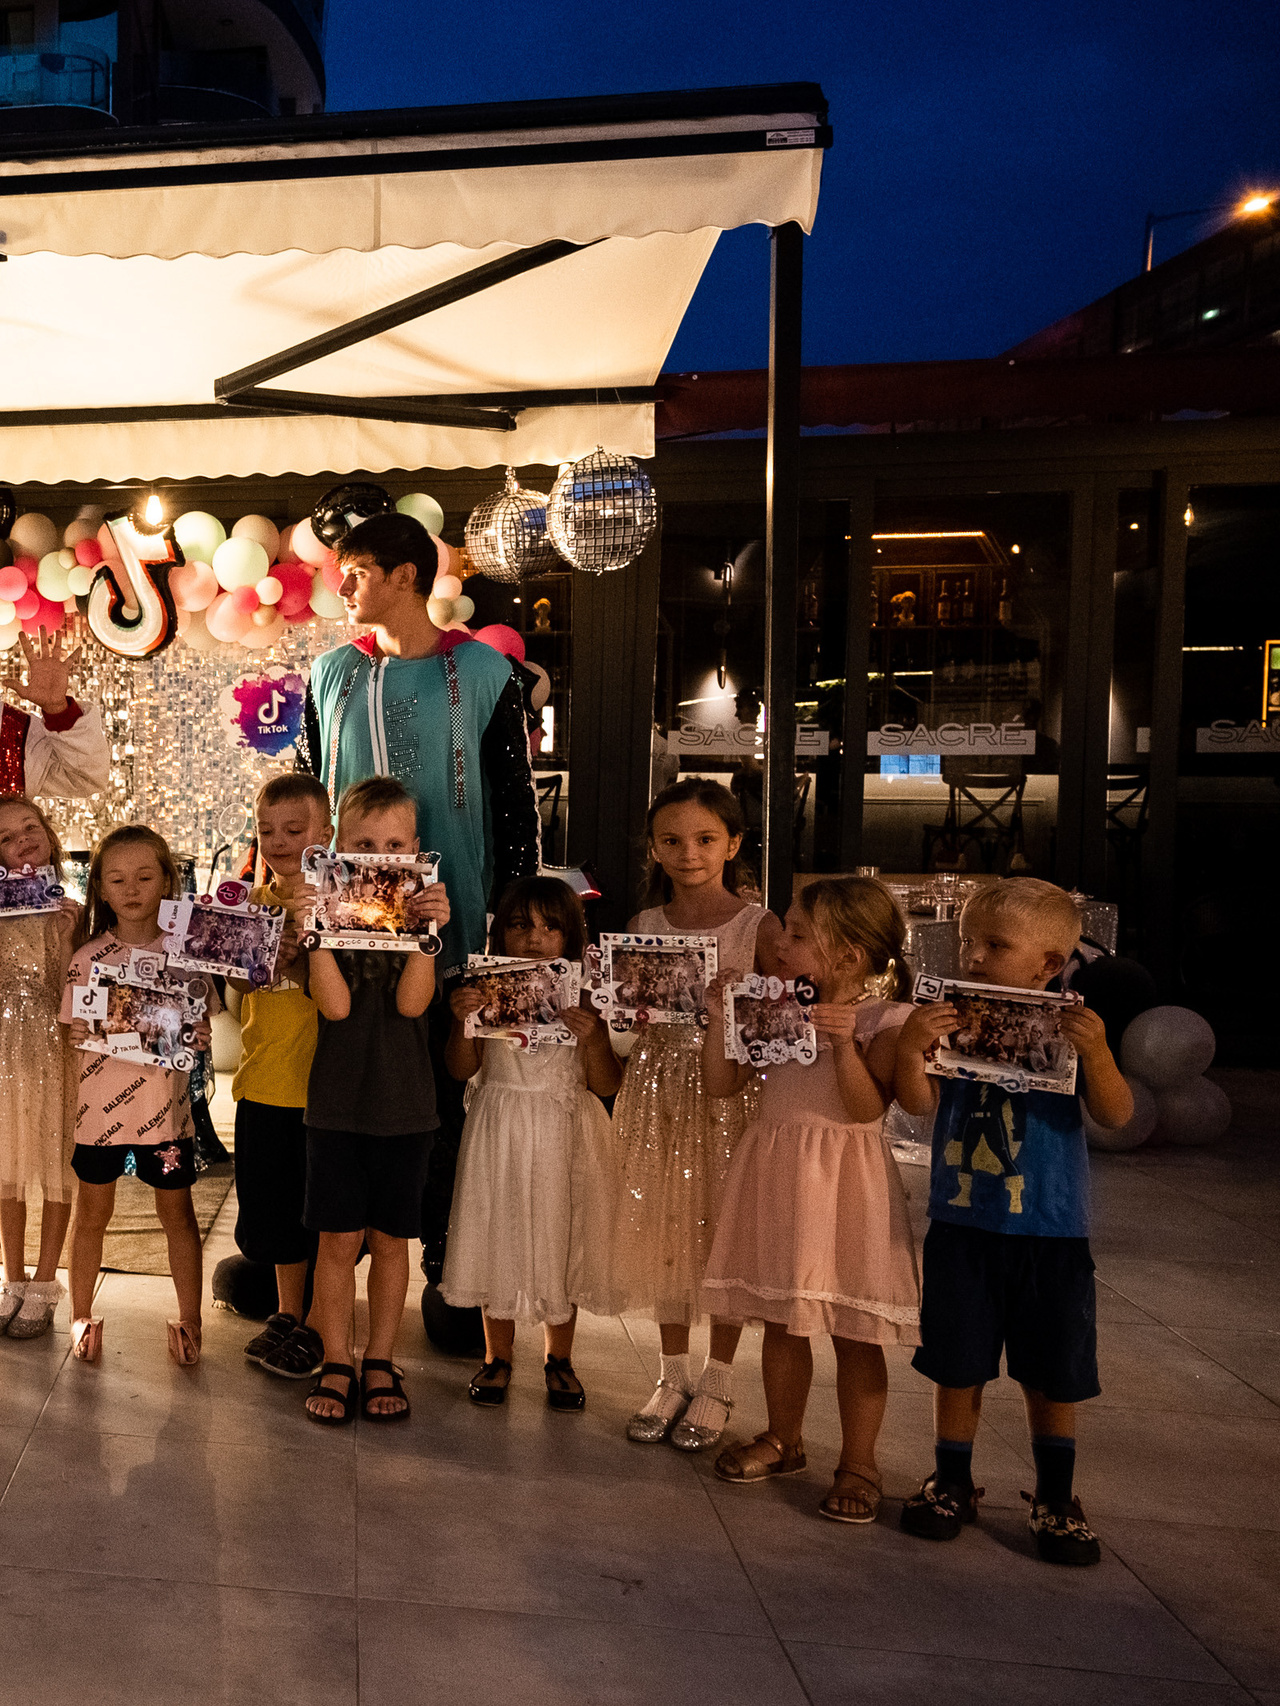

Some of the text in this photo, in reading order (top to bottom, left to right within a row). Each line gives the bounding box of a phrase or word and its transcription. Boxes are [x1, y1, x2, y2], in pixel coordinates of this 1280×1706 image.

[257, 725, 289, 735] TikTok
[878, 714, 1027, 747] SACRÉ
[1208, 719, 1280, 744] SA
[102, 1076, 147, 1114] BALENCIAGA
